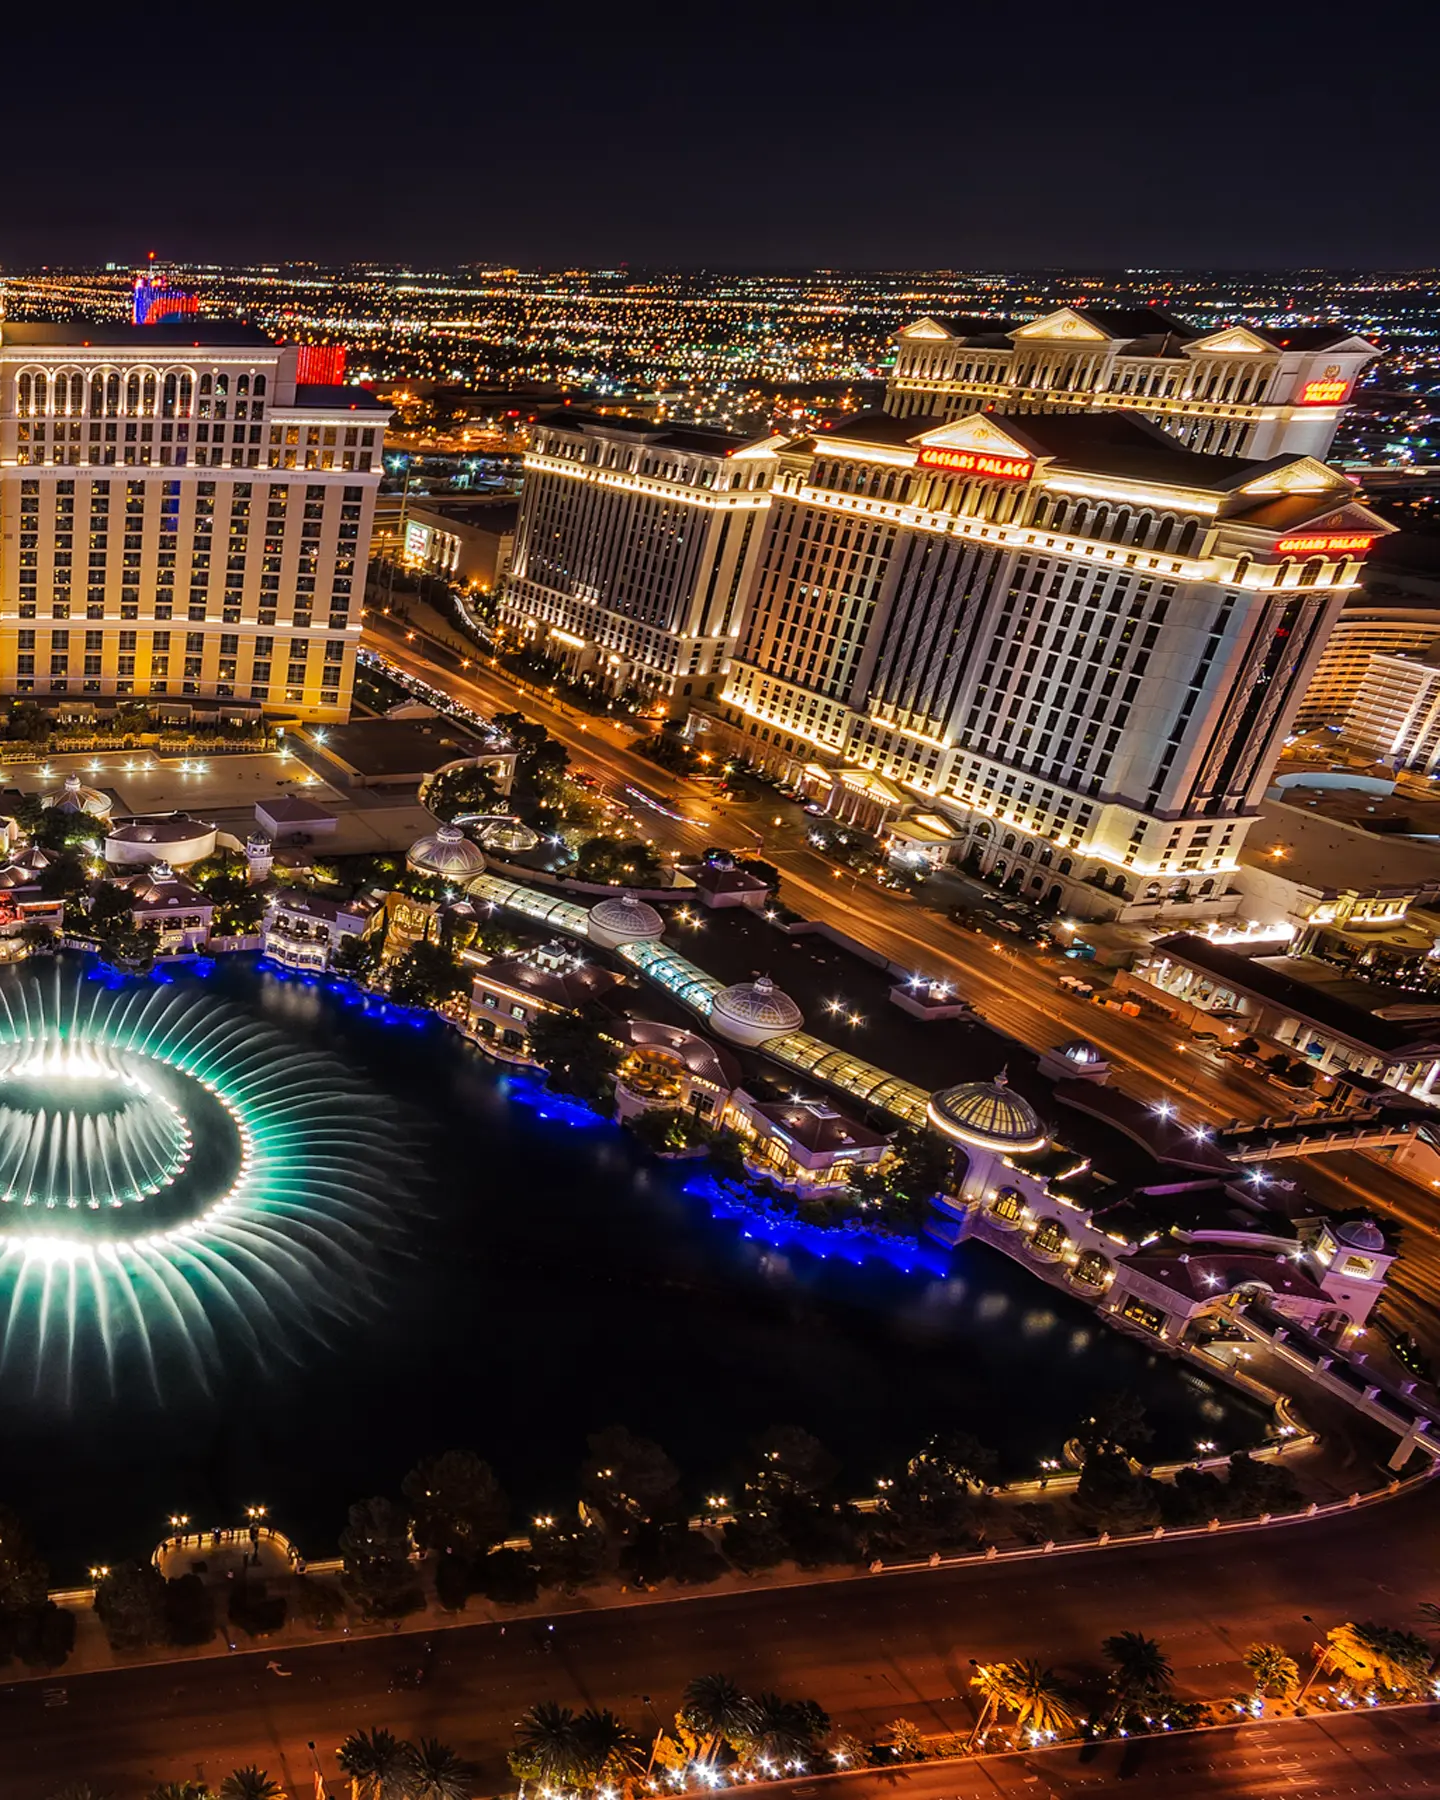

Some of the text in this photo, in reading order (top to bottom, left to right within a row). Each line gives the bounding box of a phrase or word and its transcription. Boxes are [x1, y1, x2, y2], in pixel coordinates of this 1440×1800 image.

[921, 450, 1031, 478] CAESARS PALACE
[1279, 537, 1371, 551] CAESARS PALACE
[691, 1075, 720, 1093] OLIVES
